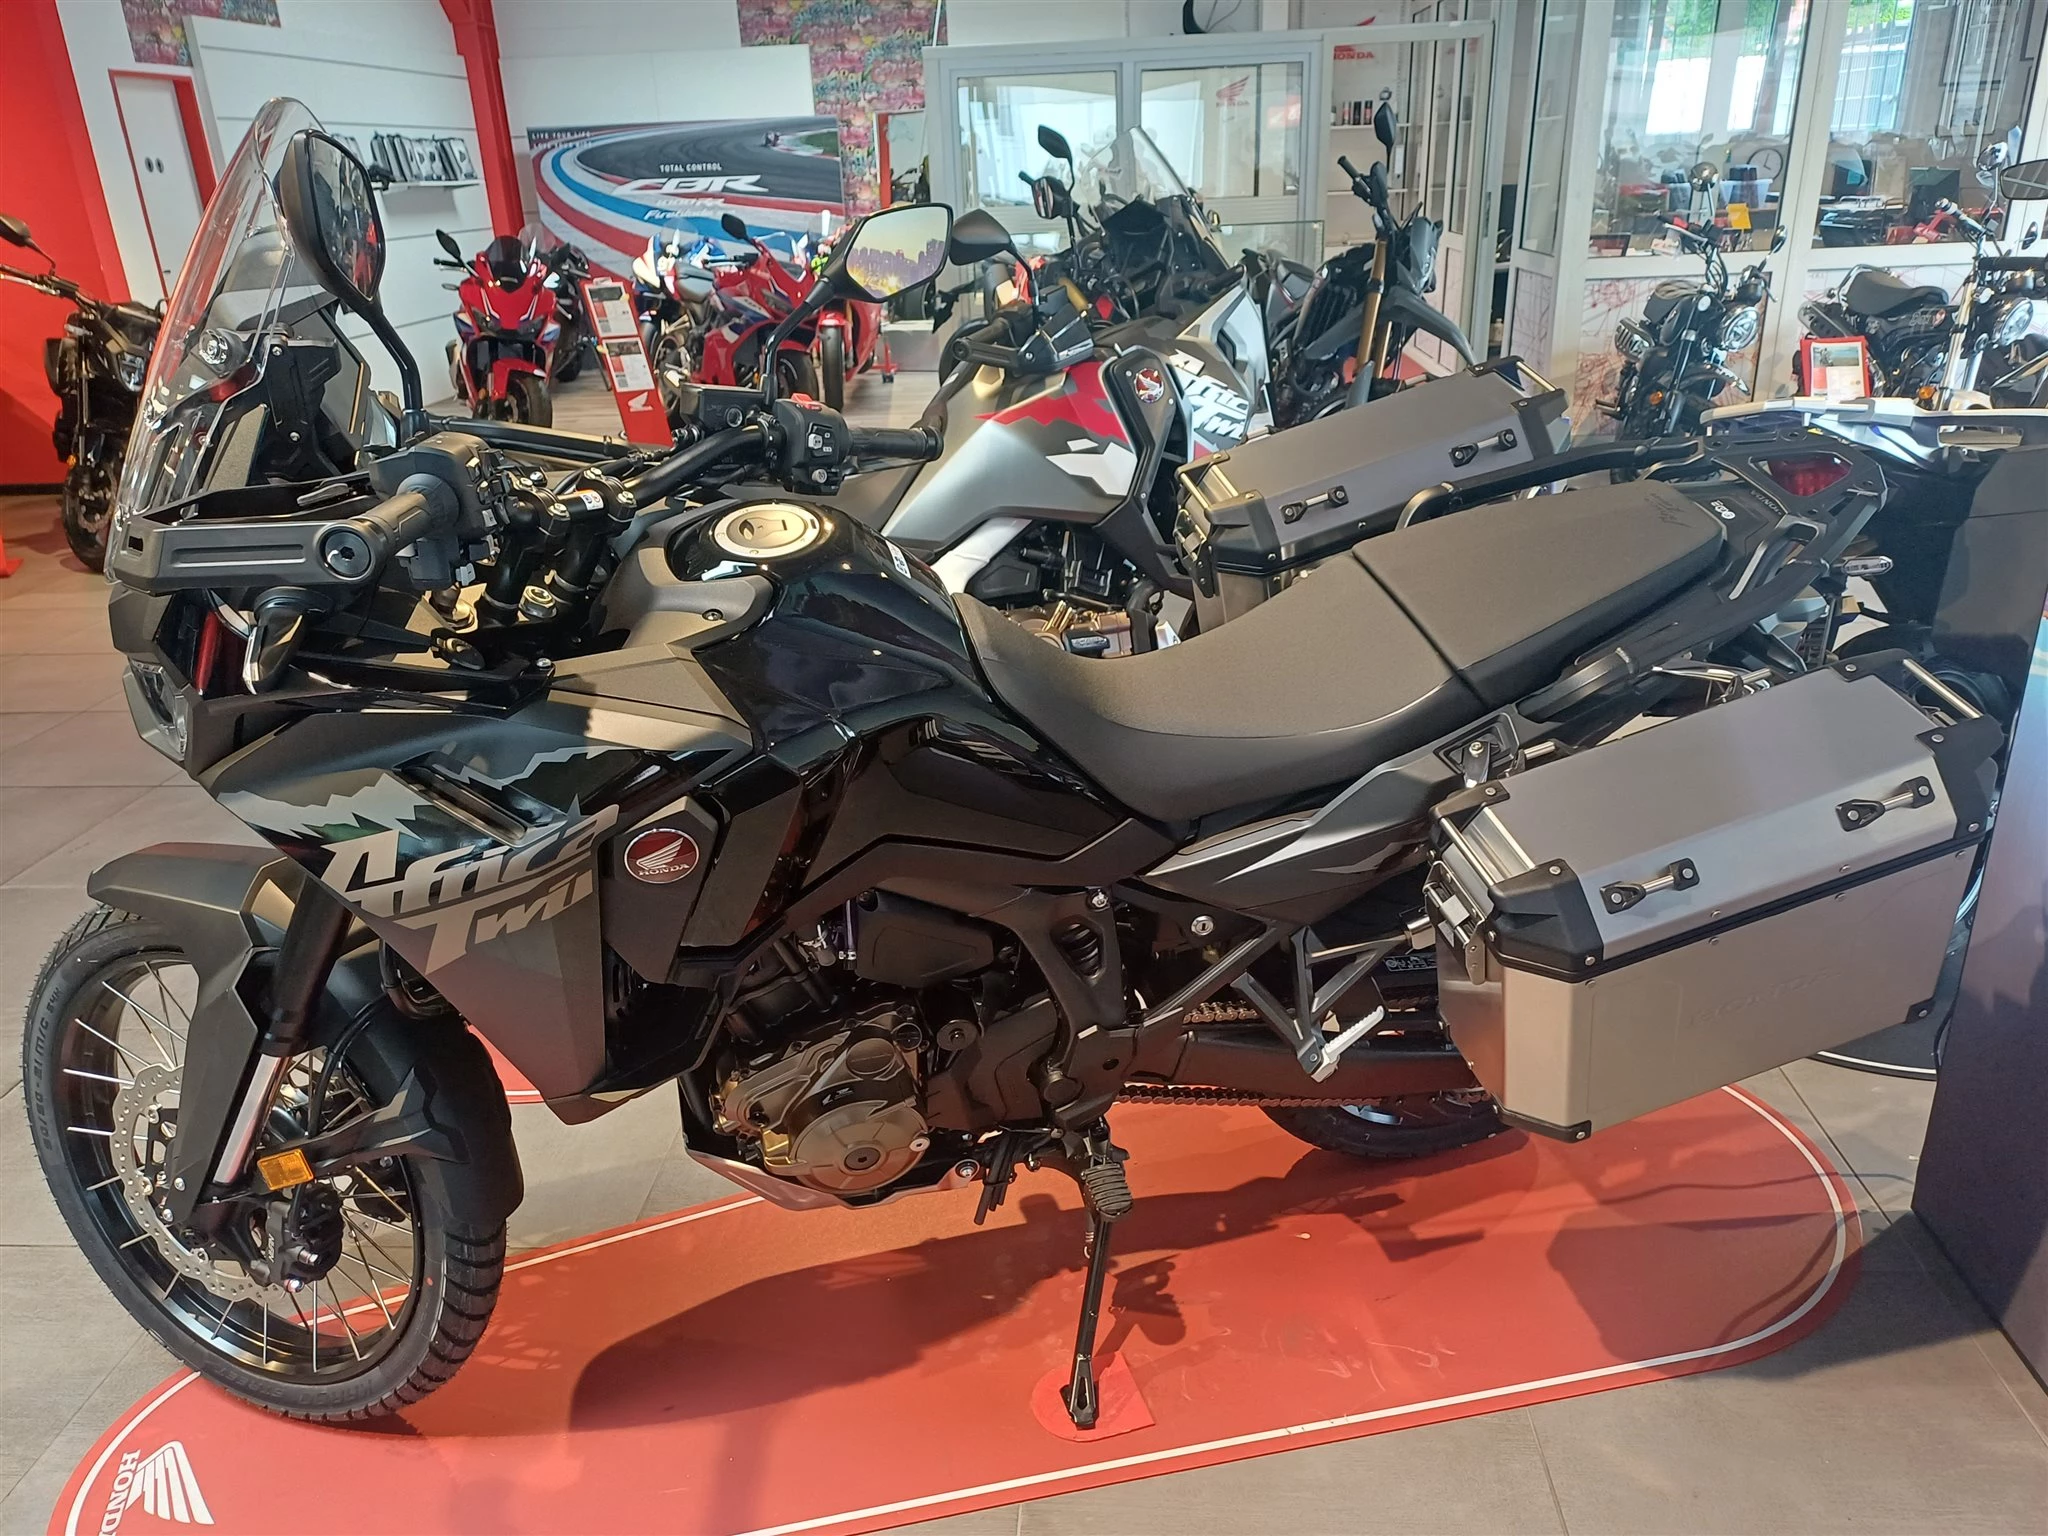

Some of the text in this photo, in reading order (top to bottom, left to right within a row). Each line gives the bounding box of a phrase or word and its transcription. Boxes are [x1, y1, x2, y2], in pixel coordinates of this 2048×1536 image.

[660, 162, 722, 173] TOTAL CONTROL
[611, 174, 769, 195] CBR
[320, 804, 620, 918] Africa
[638, 863, 690, 876] HONDA
[98, 1449, 141, 1536] HOND
